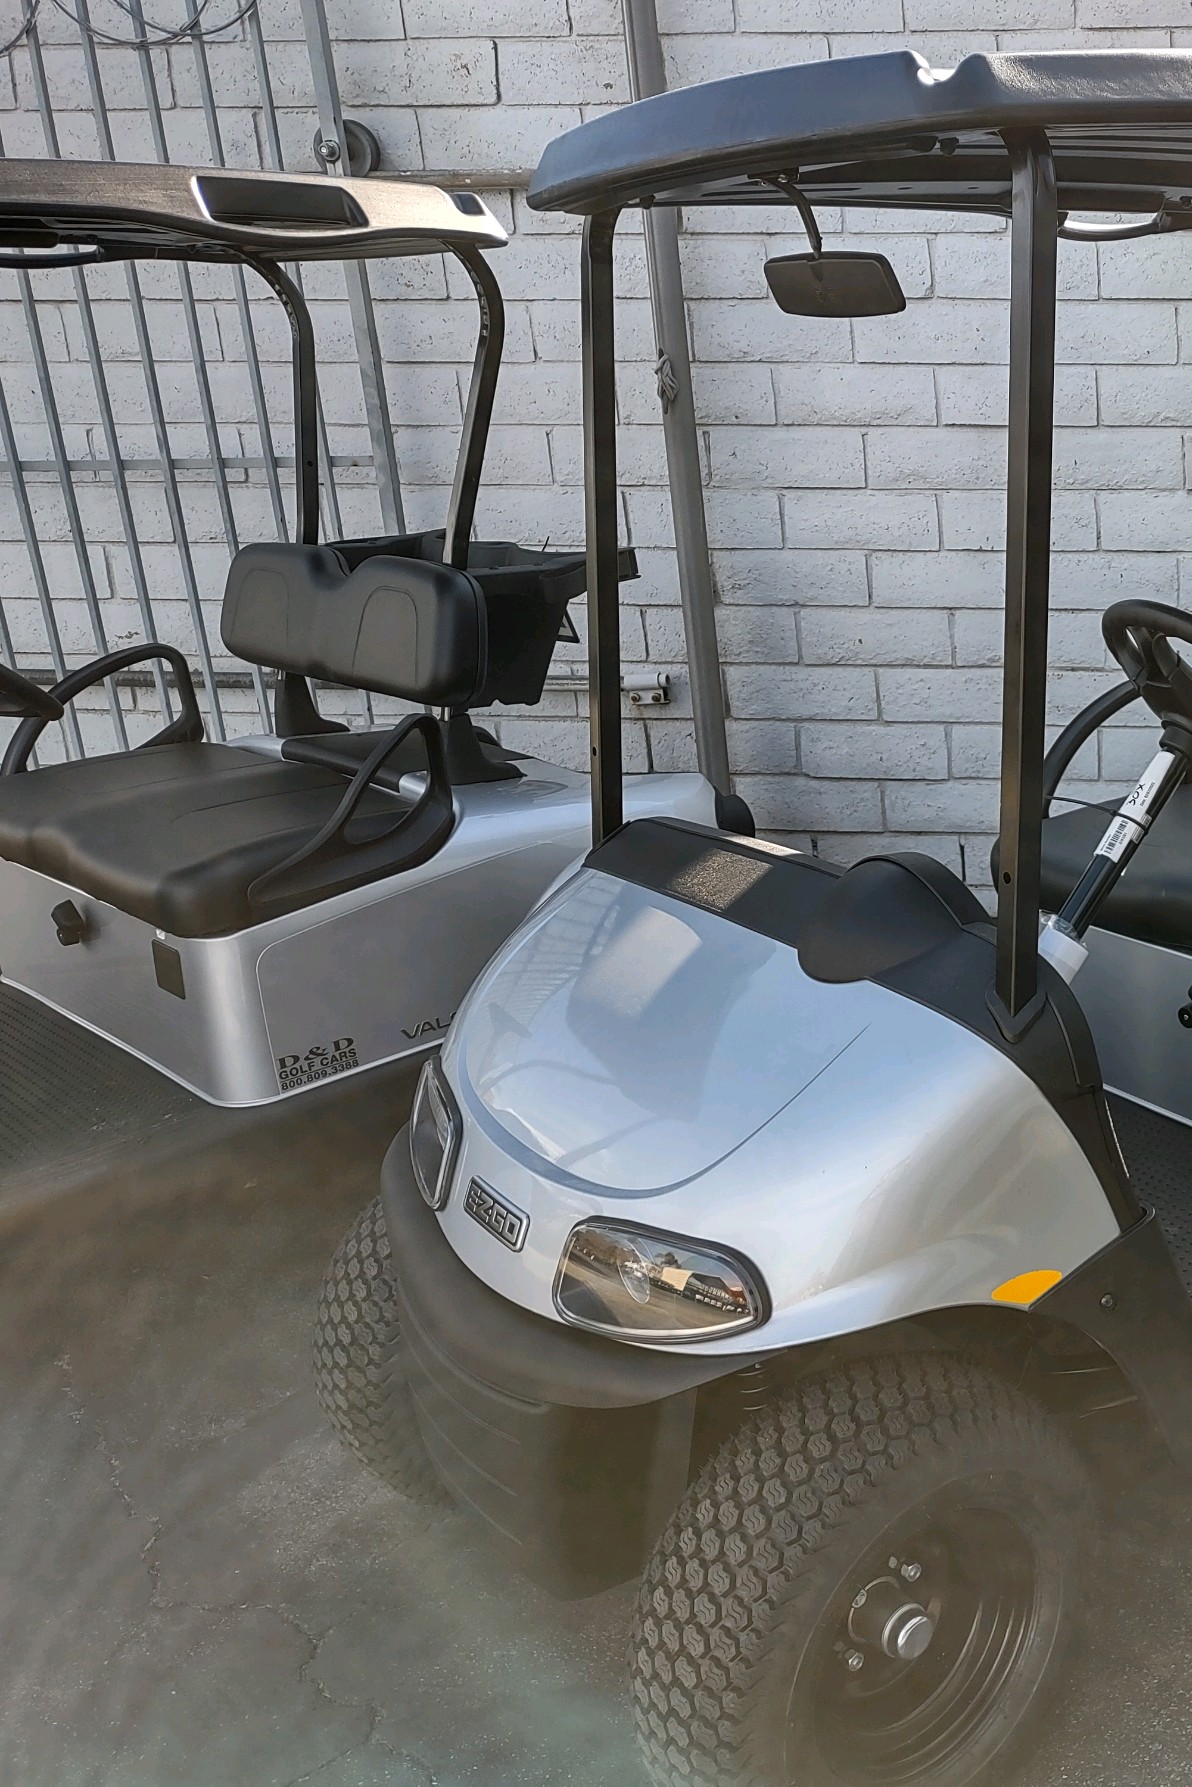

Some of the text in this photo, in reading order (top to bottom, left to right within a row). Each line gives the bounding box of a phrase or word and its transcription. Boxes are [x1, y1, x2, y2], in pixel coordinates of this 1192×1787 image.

[279, 1048, 357, 1080] GOLF CARS
[281, 1060, 359, 1091] 800.809.3388
